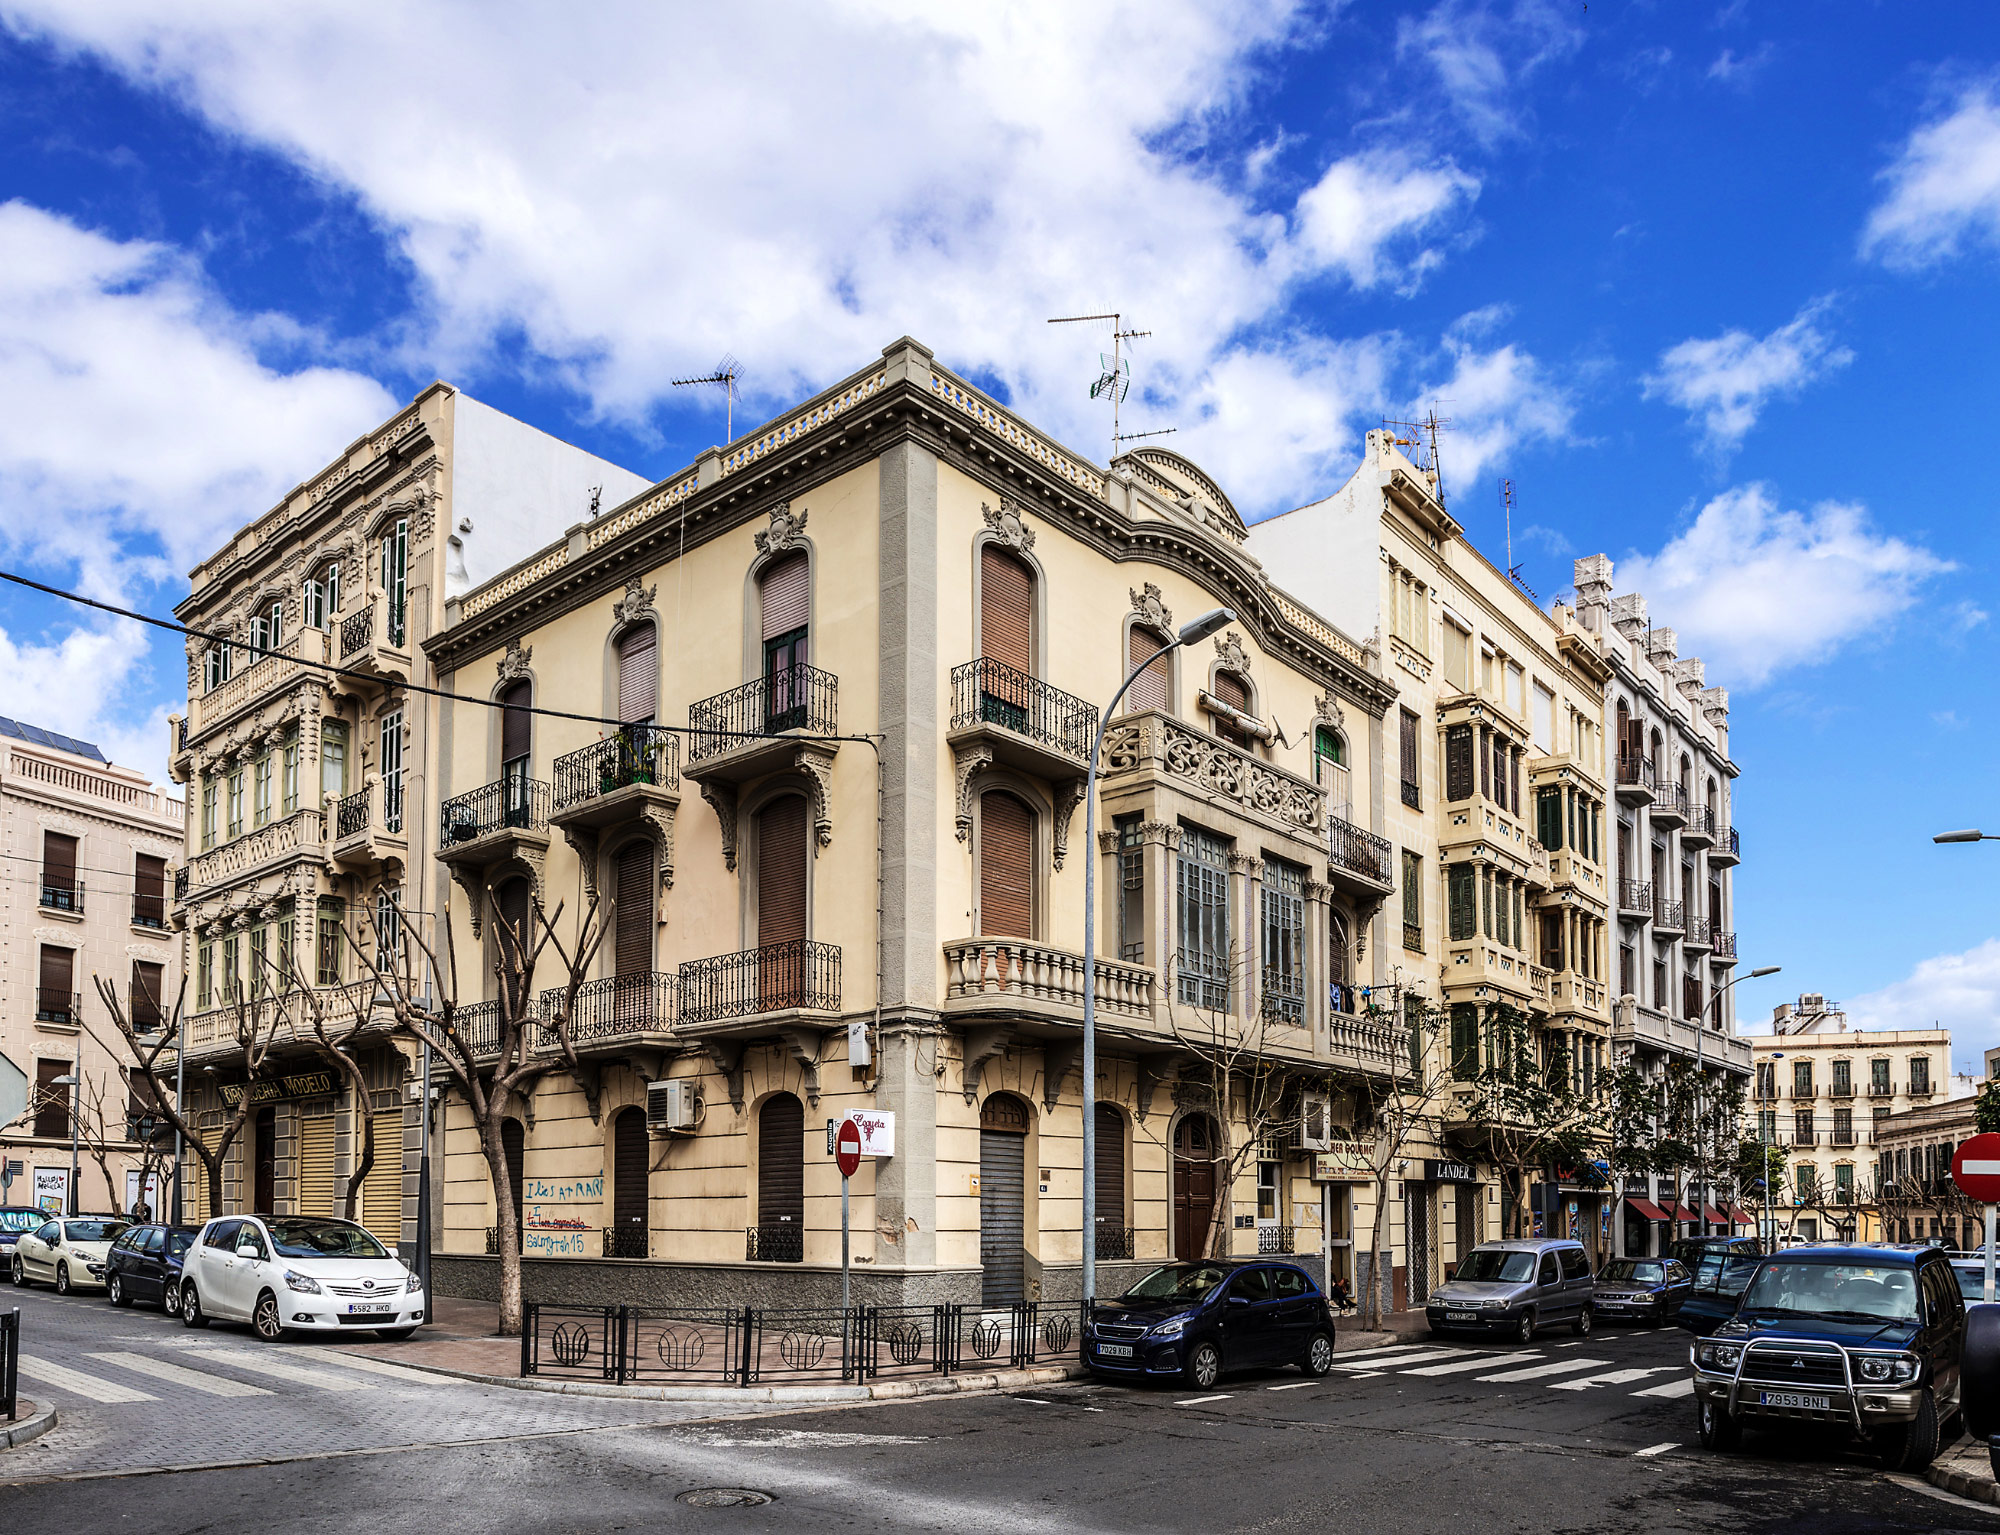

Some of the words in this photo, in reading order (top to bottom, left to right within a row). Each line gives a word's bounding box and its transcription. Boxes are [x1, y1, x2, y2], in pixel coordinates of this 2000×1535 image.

[224, 1081, 283, 1104] DROUERIA
[284, 1074, 331, 1096] MODELO
[1437, 1163, 1470, 1179] LANDER
[1101, 1345, 1117, 1354] 7029
[1767, 1393, 1799, 1406] 7953
[1803, 1396, 1828, 1409] BNL
